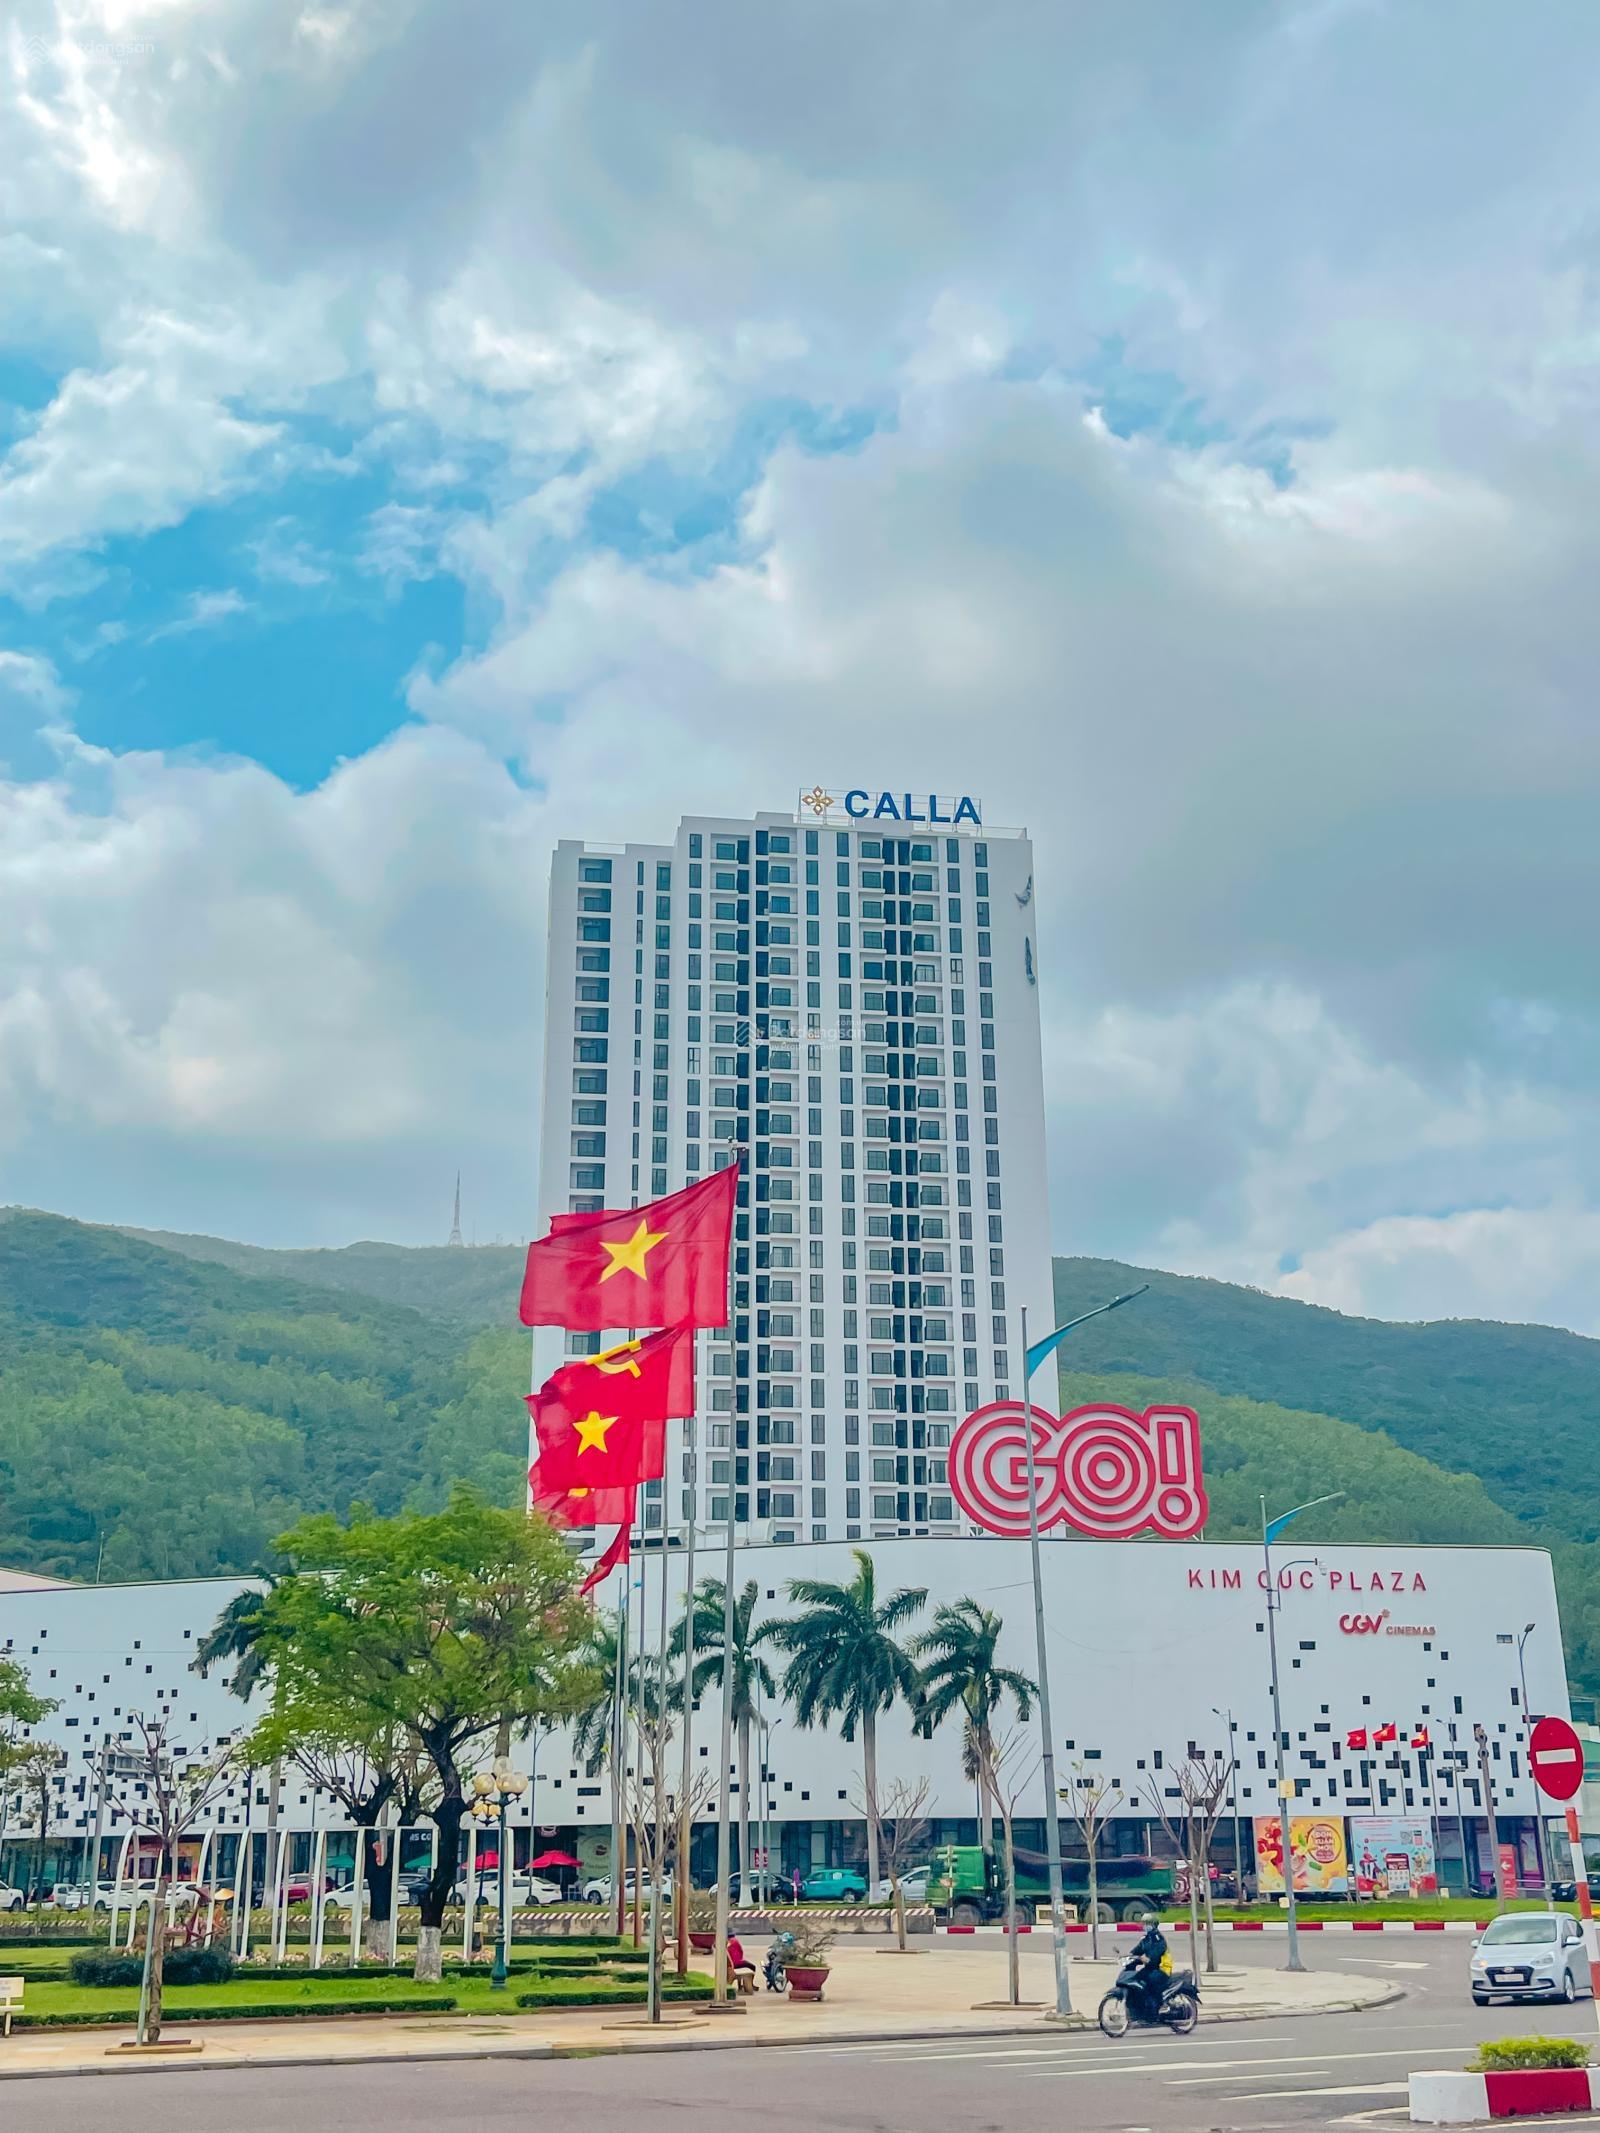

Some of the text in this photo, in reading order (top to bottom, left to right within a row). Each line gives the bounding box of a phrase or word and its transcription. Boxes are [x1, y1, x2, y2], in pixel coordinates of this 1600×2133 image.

[844, 790, 981, 825] CALLA
[949, 1401, 1209, 1539] GO!
[1188, 1569, 1242, 1589] KIM
[1330, 1571, 1427, 1592] PLAZA
[1339, 1613, 1436, 1635] CGV CINEMAS
